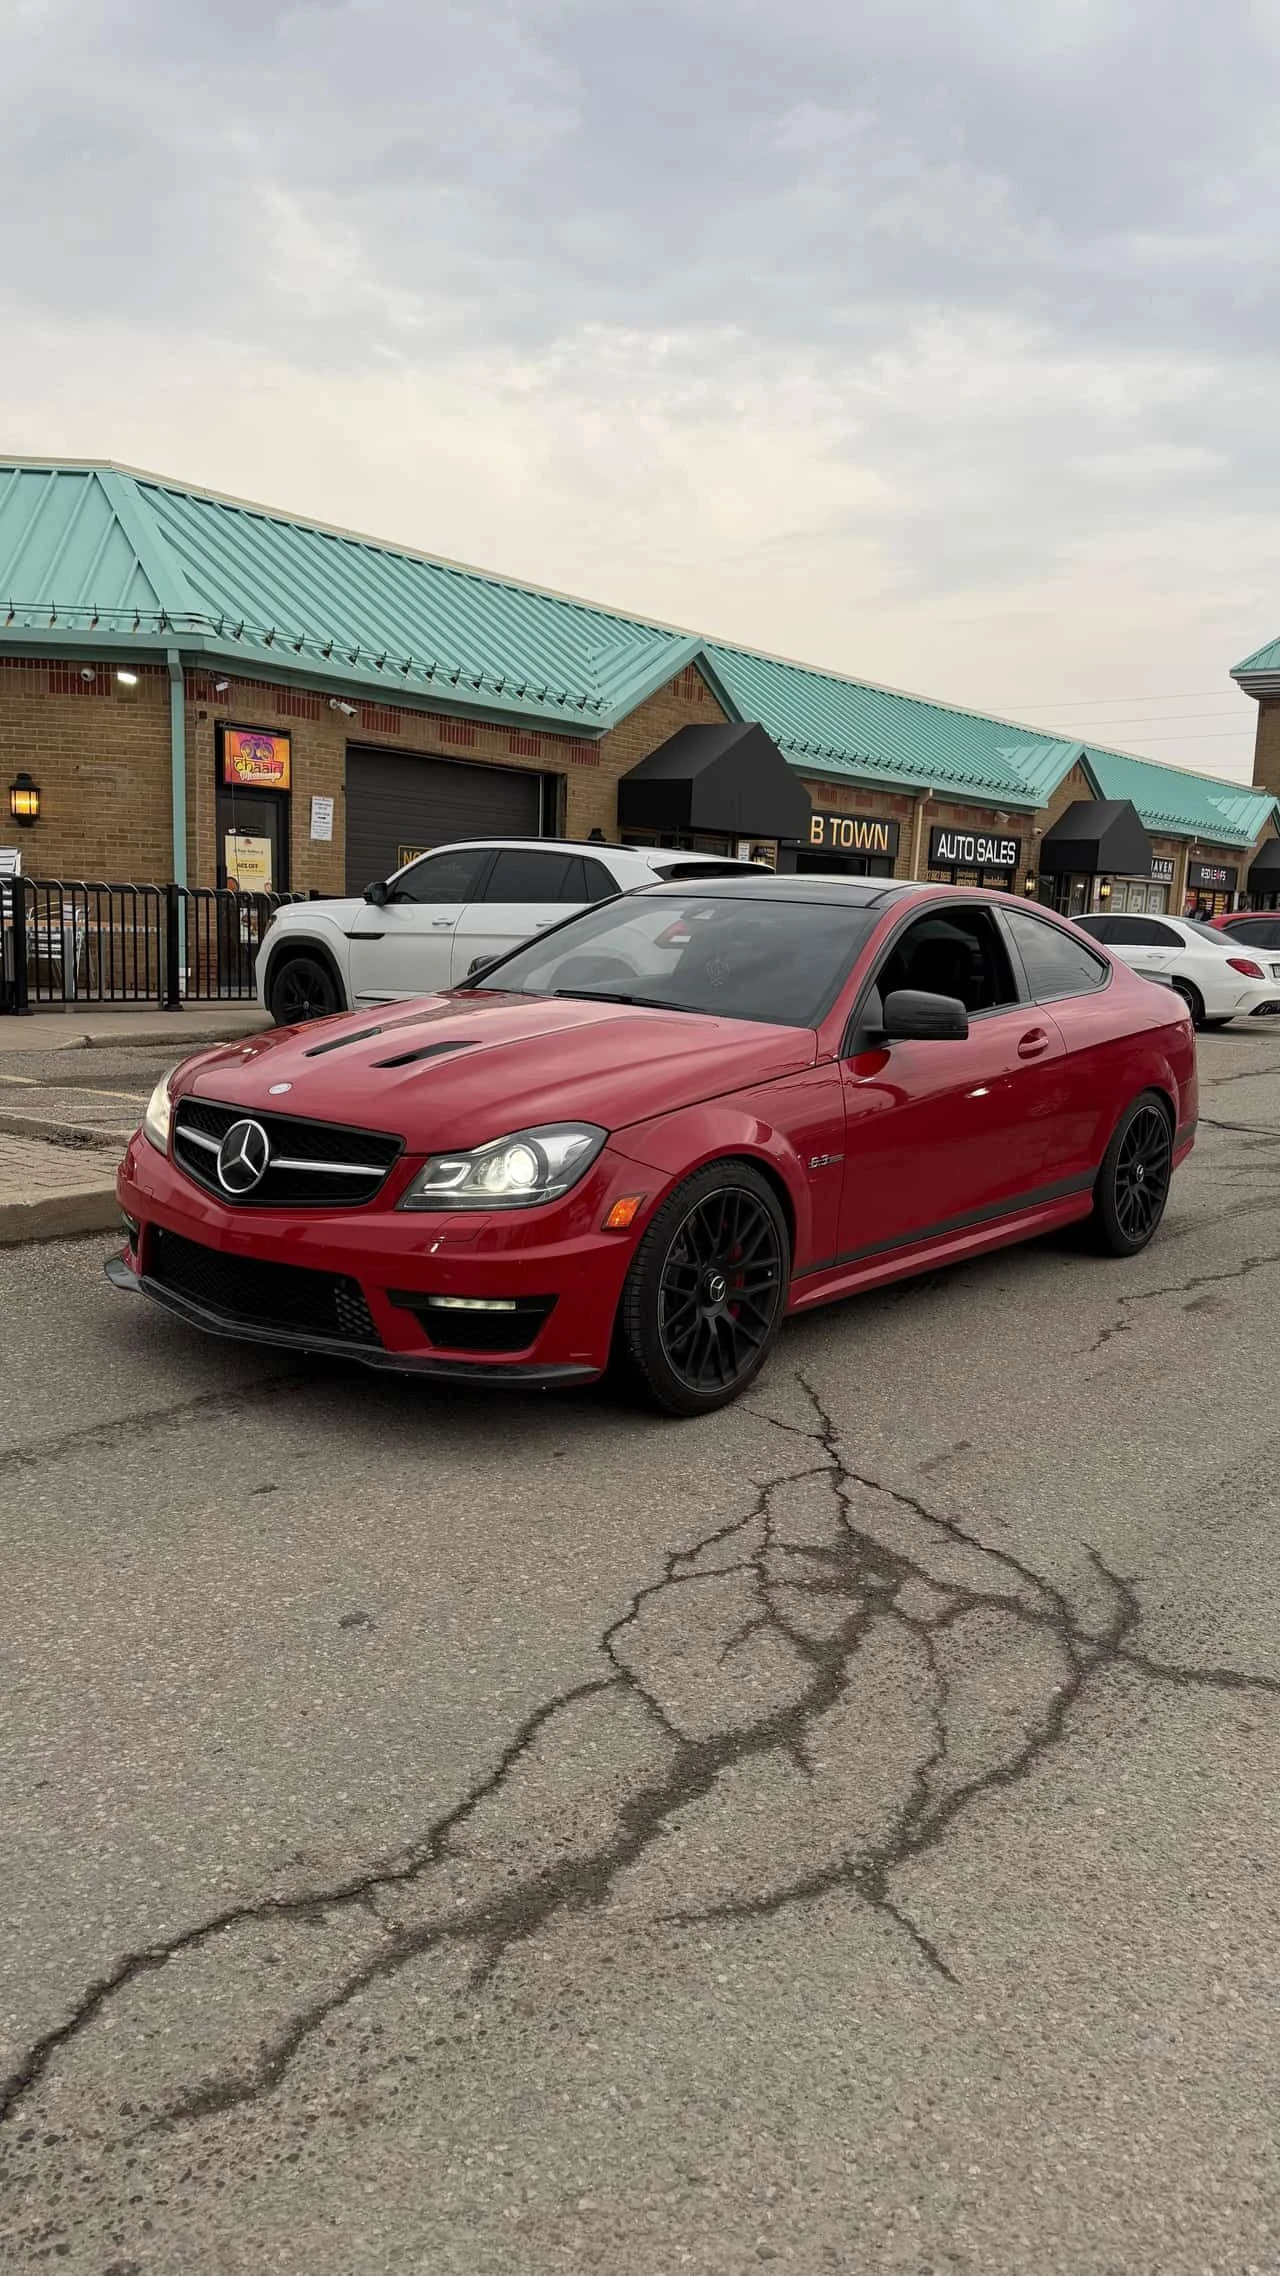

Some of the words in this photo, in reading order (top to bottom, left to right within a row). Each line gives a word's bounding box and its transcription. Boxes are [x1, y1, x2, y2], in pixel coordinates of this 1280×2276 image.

[810, 815, 824, 845] B
[829, 817, 889, 851] TOWN
[937, 833, 975, 861] AUTO
[976, 838, 1016, 865] SALES
